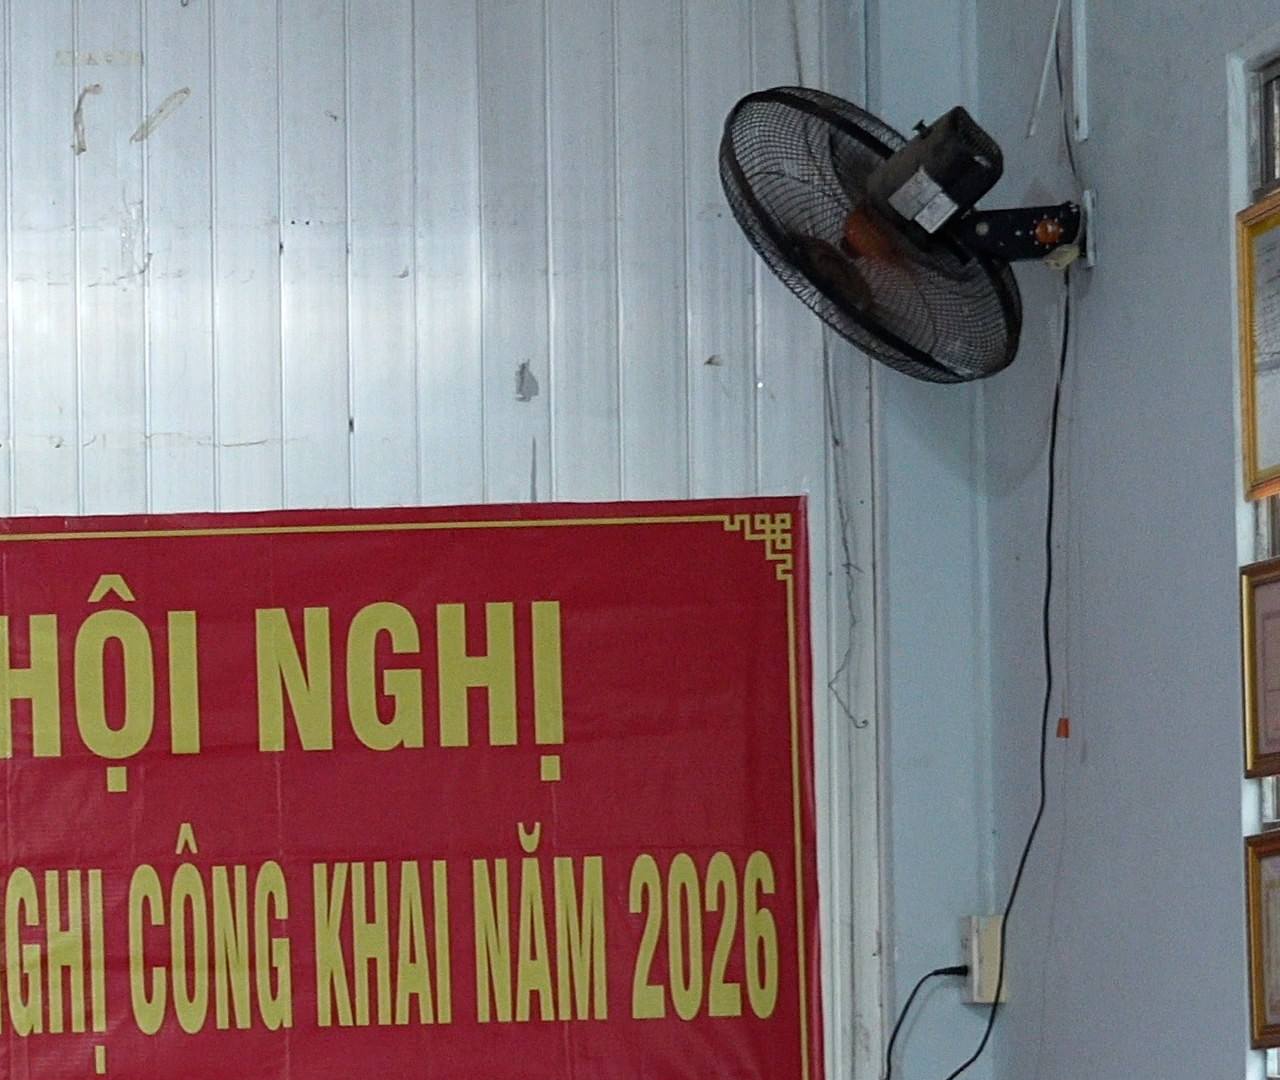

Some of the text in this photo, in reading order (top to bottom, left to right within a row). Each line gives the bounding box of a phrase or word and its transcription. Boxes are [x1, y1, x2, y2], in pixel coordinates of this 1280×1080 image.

[256, 601, 564, 781] NGHỊ
[129, 823, 293, 1035] CÔNG
[314, 859, 452, 1027] KHAI
[473, 821, 608, 1023] NĂM
[630, 851, 778, 1021] 2026
